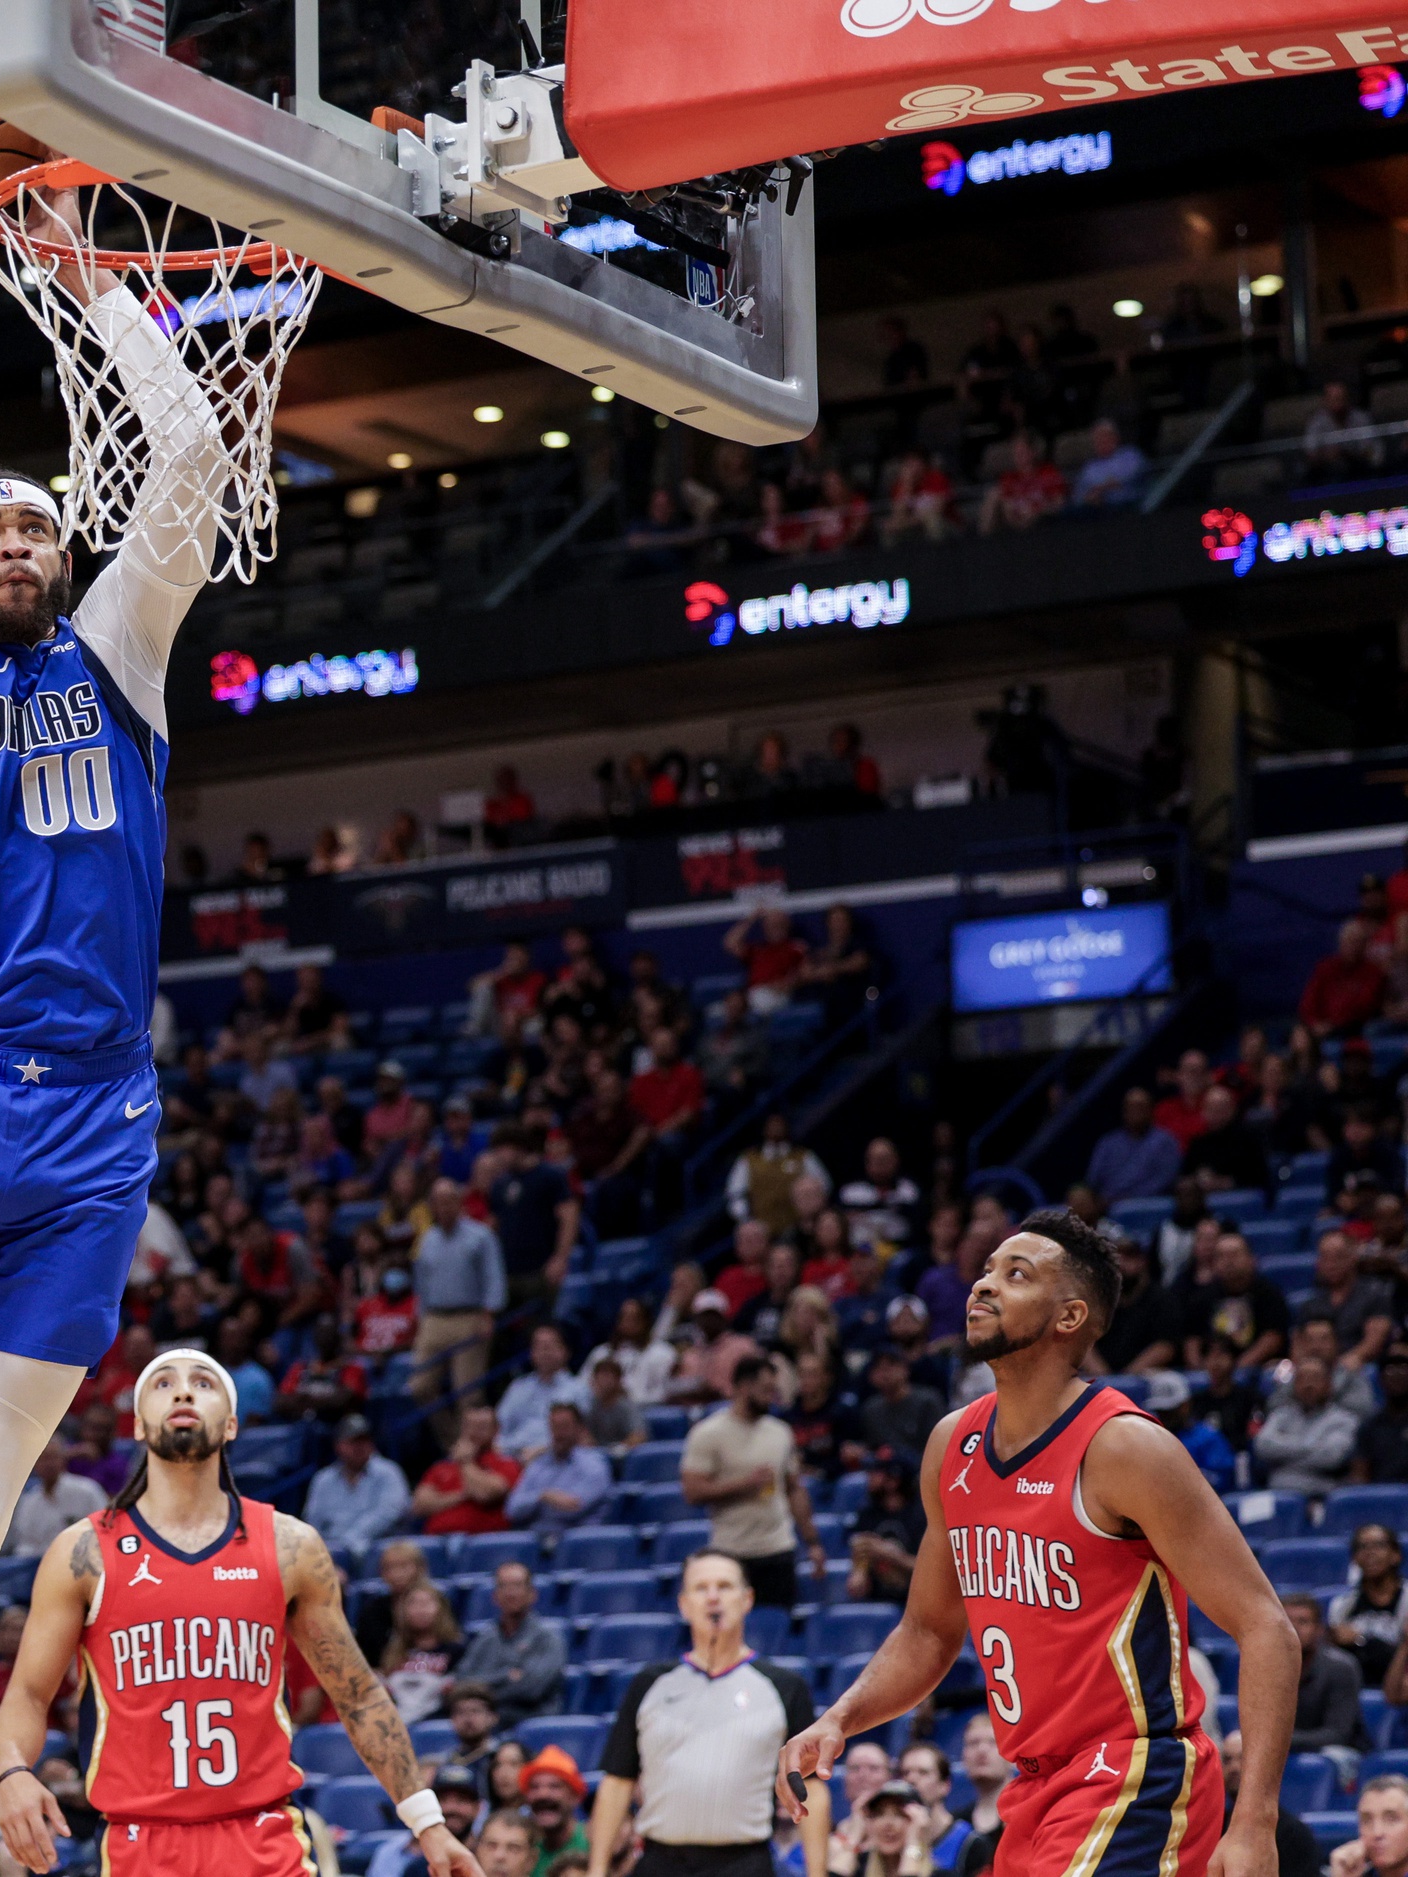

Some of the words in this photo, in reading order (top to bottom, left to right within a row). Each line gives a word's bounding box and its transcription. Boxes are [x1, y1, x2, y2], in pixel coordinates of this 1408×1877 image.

[1042, 44, 1336, 101] State
[1335, 26, 1408, 64] F
[966, 131, 1112, 184] entergy
[693, 266, 712, 301] NBA
[1264, 506, 1408, 563] enterg
[738, 578, 910, 635] entergy
[21, 746, 117, 836] 00
[964, 1434, 982, 1454] 6
[1016, 1477, 1055, 1495] ibotta
[121, 1536, 138, 1554] 6
[213, 1566, 259, 1581] ibotta
[948, 1525, 1081, 1611] ELICANS
[109, 1616, 276, 1692] PELICANS
[981, 1625, 1023, 1725] 3
[160, 1698, 240, 1789] 15
